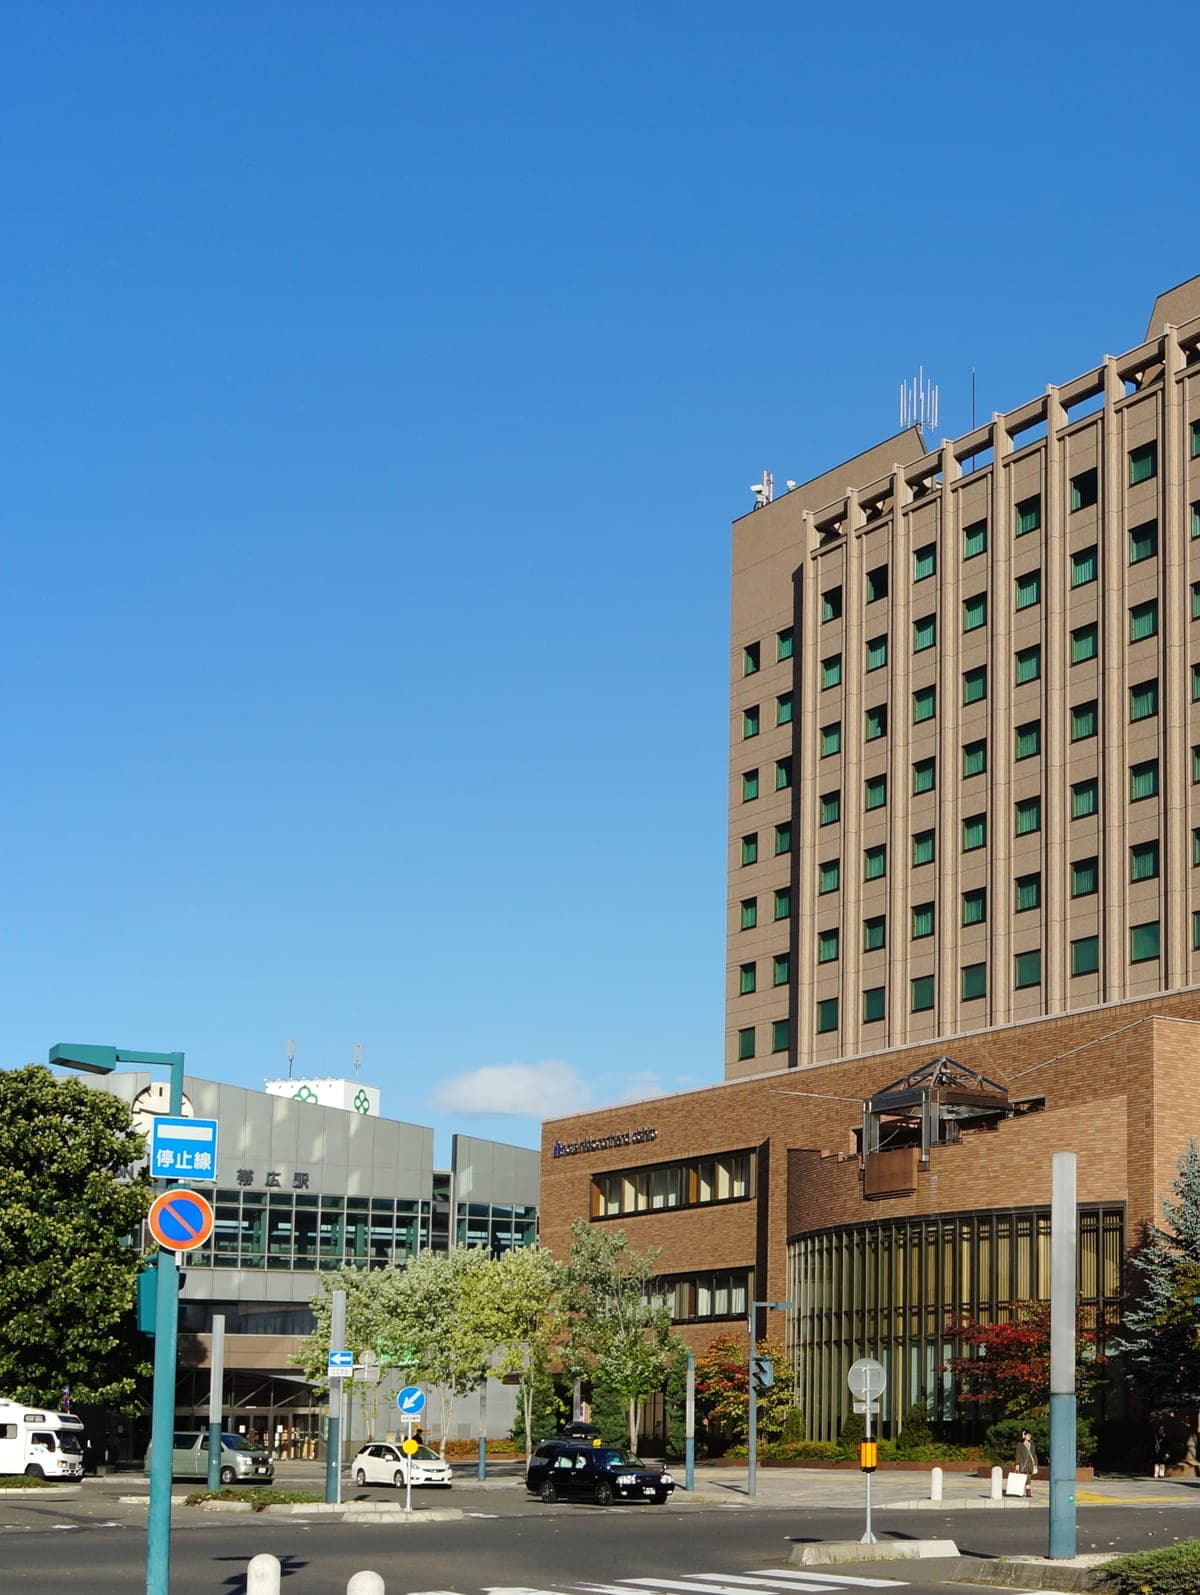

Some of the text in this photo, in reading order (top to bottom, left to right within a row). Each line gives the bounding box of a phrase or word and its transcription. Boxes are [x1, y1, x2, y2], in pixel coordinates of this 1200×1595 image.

[156, 1149, 212, 1170] 停止線
[236, 1168, 309, 1189] 帯広駅
